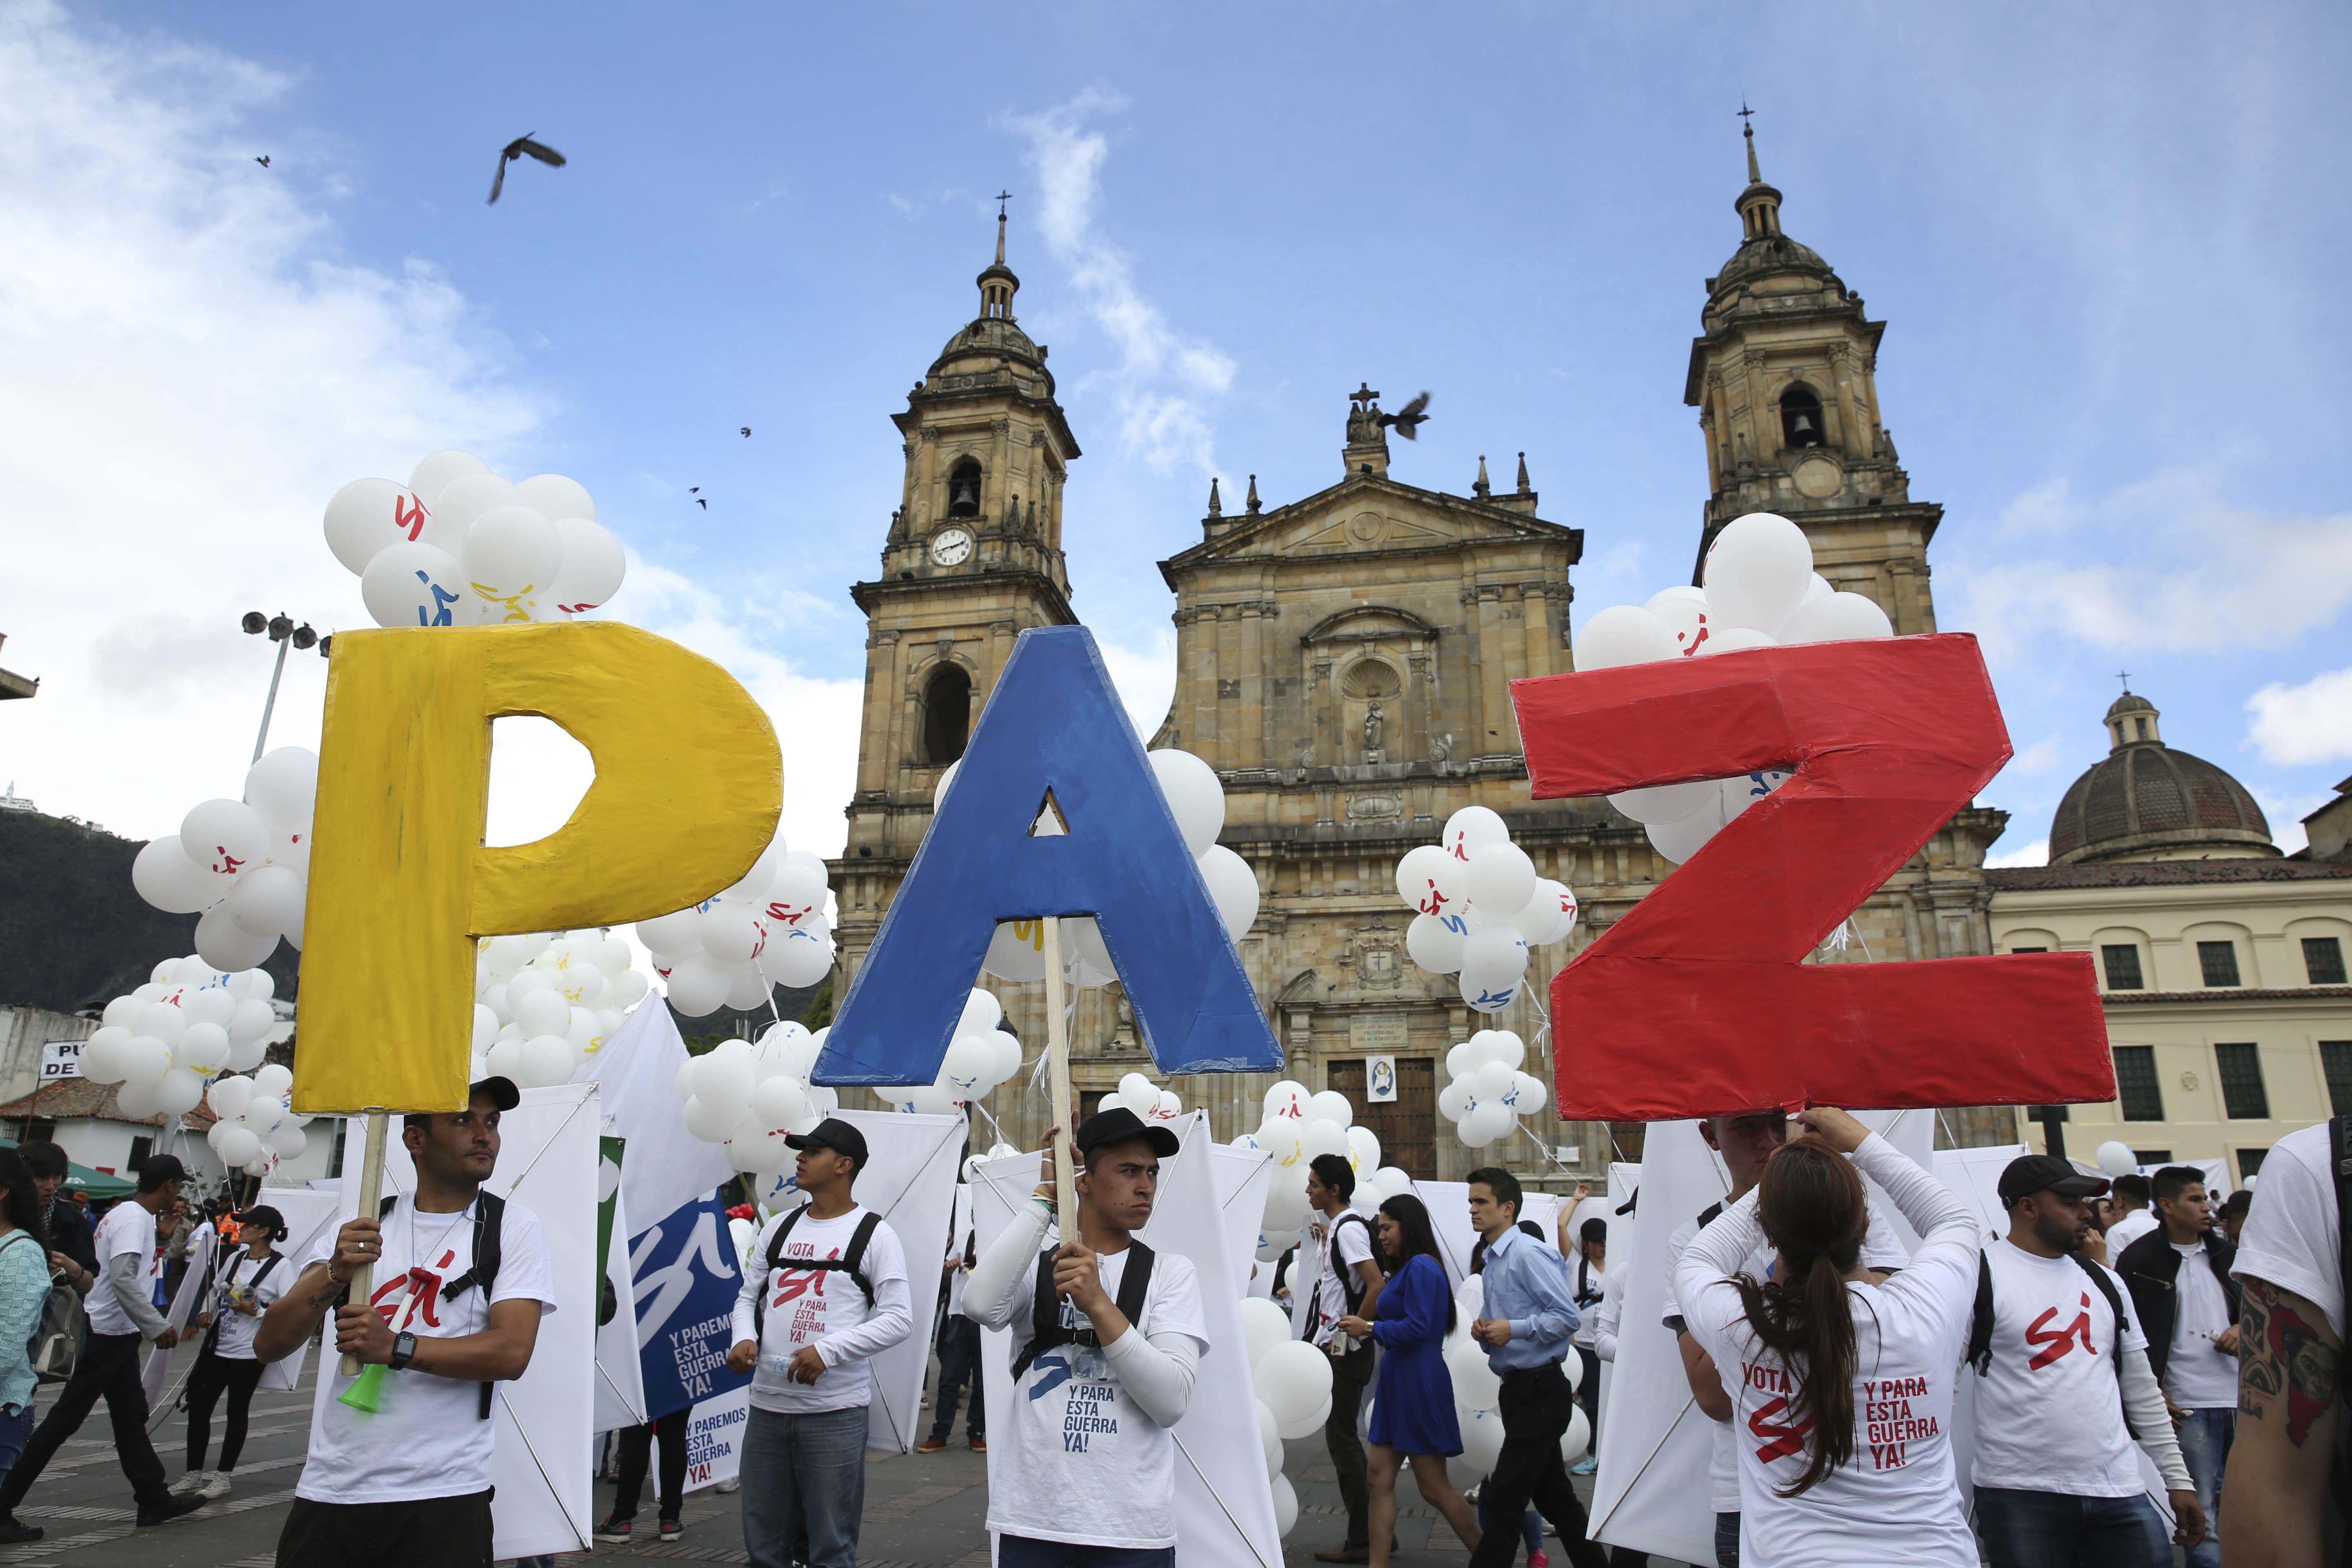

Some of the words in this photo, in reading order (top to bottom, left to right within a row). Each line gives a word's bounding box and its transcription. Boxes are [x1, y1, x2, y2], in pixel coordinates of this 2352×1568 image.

[45, 1063, 75, 1075] DE
[787, 1242, 814, 1257] VOTA
[795, 1309, 815, 1321] ESTA
[799, 1299, 805, 1309] Y
[806, 1300, 827, 1312] PARA
[1059, 1304, 1075, 1327] TA
[668, 1332, 679, 1348] Y
[682, 1312, 733, 1344] PAREM
[790, 1329, 806, 1344] YA!
[792, 1319, 825, 1333] GUERRA
[674, 1340, 710, 1365] ESTA
[681, 1372, 713, 1399] YA!
[1742, 1361, 1793, 1394] VOTA
[1863, 1381, 1876, 1401] Y
[1882, 1376, 1928, 1400] PARA
[1069, 1385, 1078, 1400] Y
[1080, 1385, 1114, 1402] PARA
[1066, 1401, 1098, 1417] ESTA
[1866, 1399, 1913, 1422] ESTA
[695, 1407, 746, 1434] PAREMOS
[1064, 1416, 1118, 1434] GUERRA
[1867, 1416, 1939, 1444] GUERRA
[686, 1432, 714, 1452] ESTA
[1062, 1432, 1089, 1453] YA!
[688, 1442, 731, 1467] GUERRA
[1869, 1442, 1907, 1470] YA!
[688, 1462, 712, 1484] YA!
